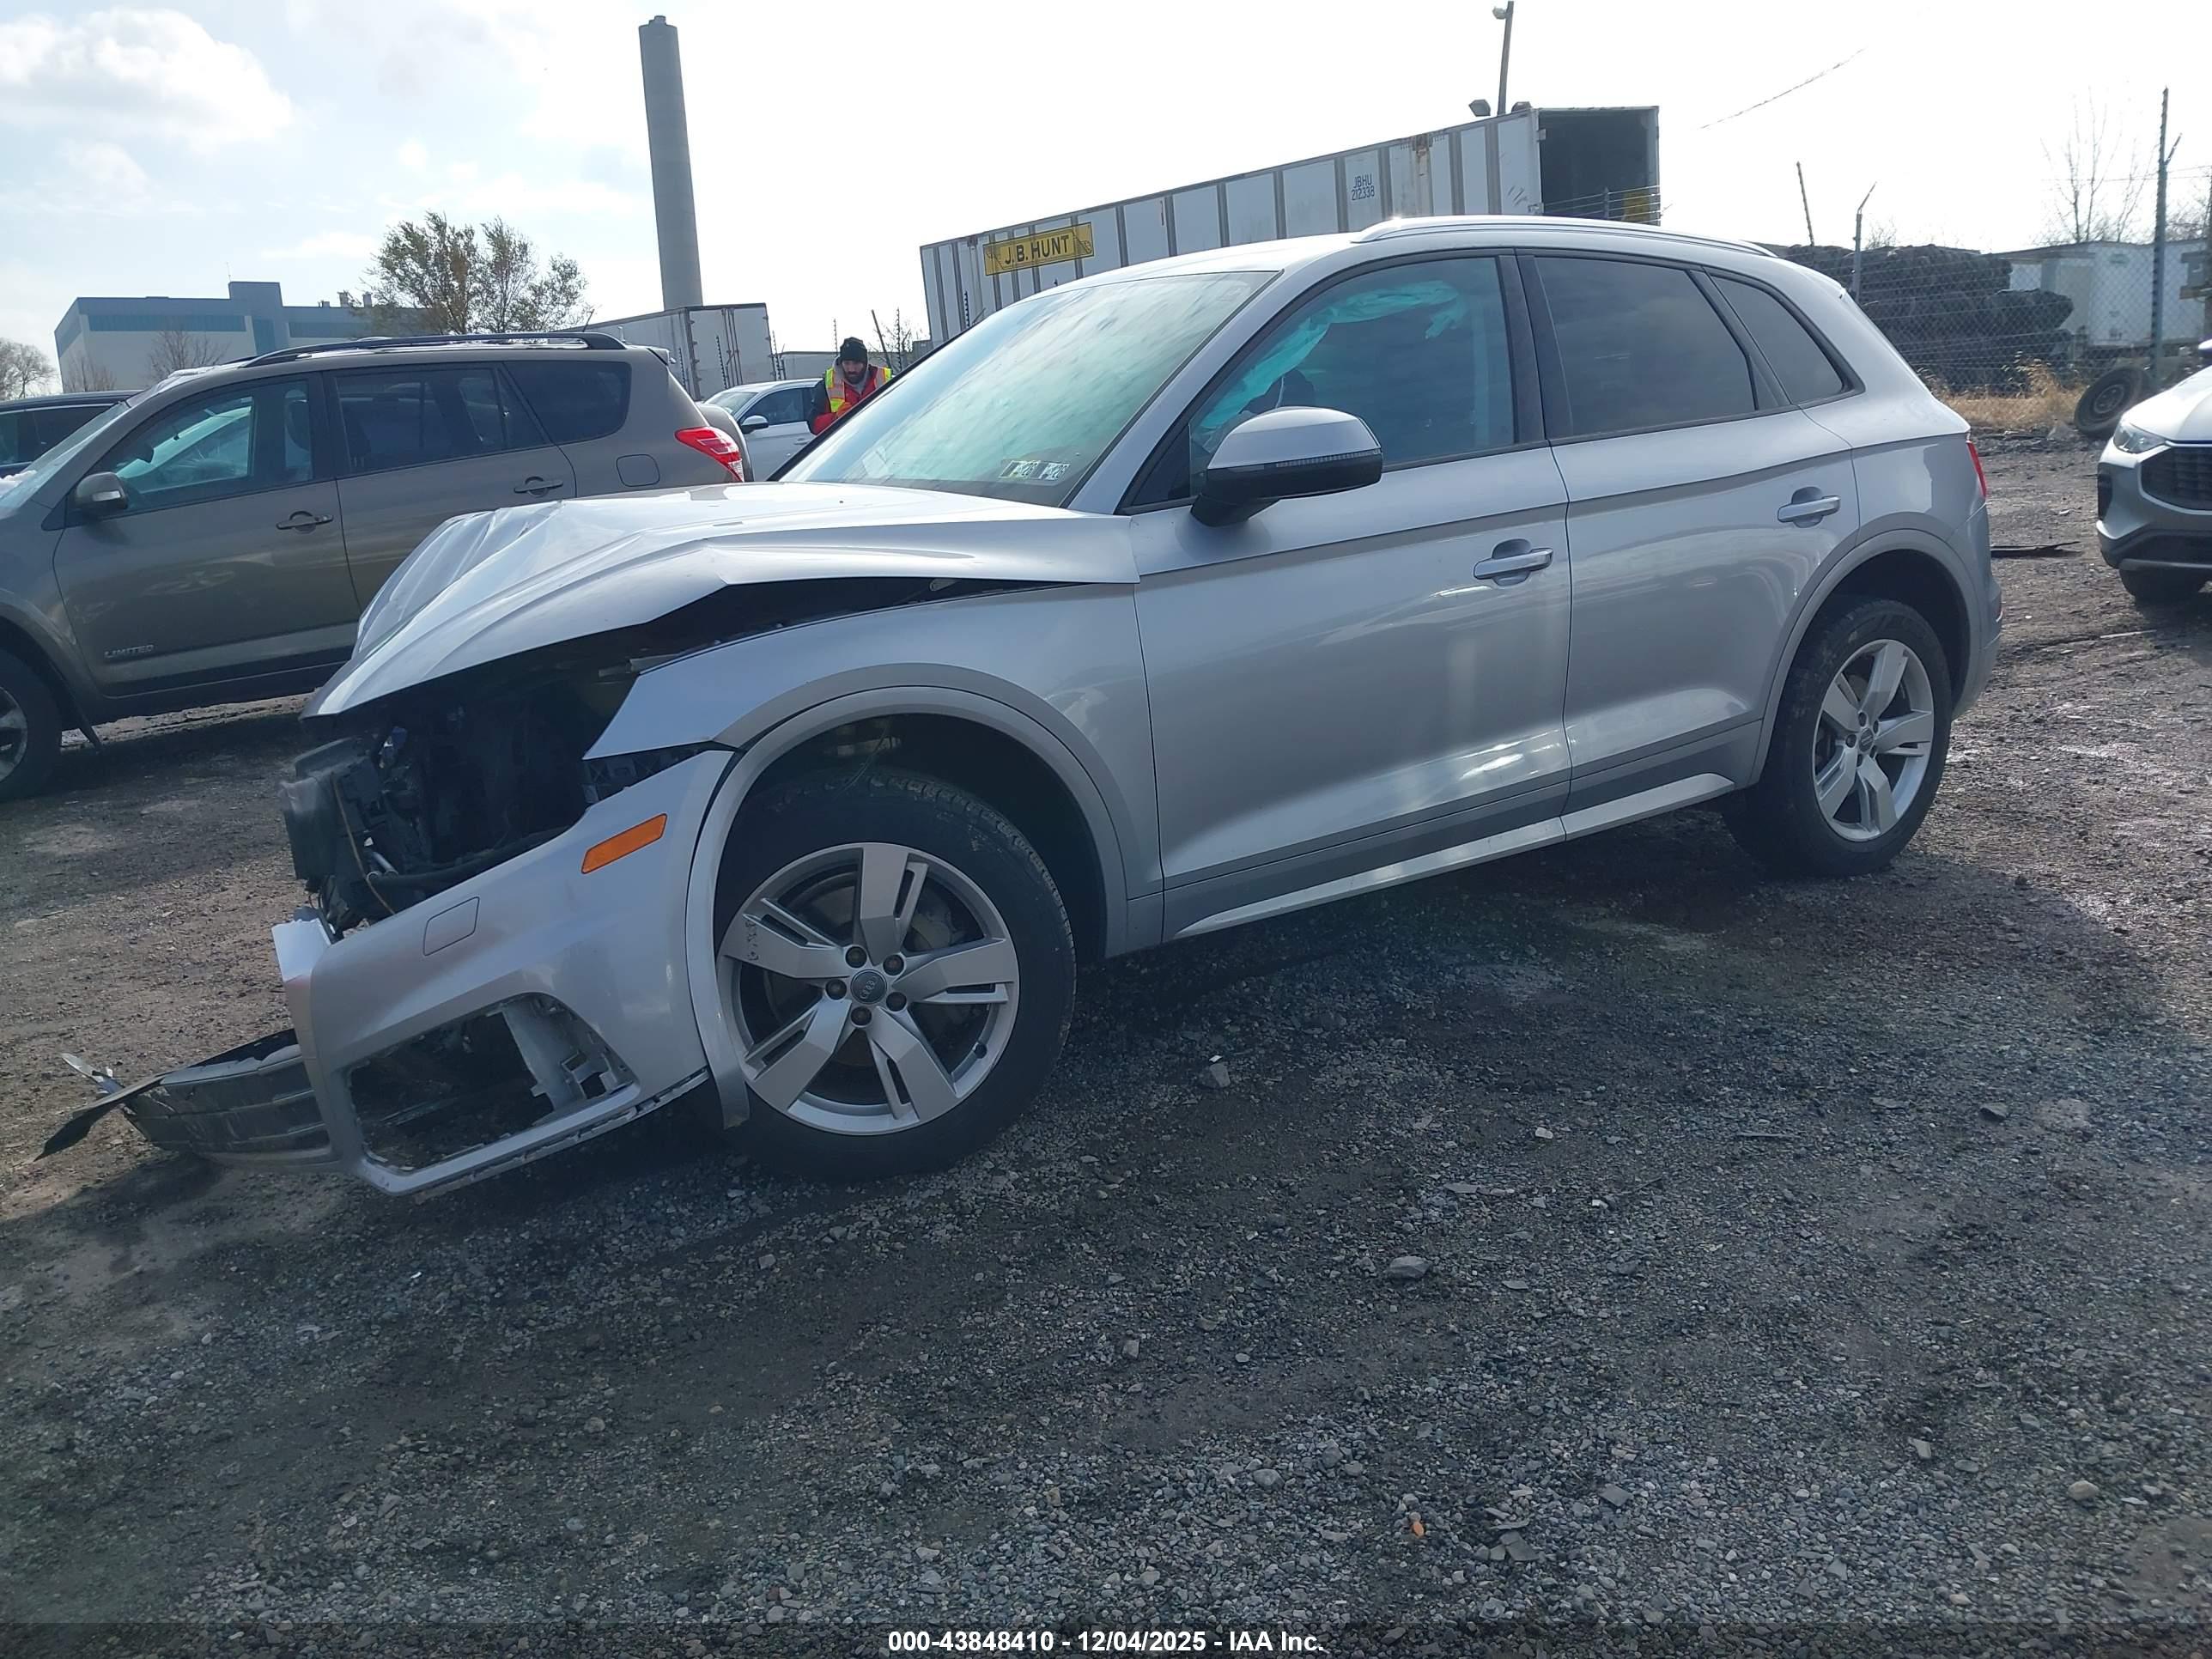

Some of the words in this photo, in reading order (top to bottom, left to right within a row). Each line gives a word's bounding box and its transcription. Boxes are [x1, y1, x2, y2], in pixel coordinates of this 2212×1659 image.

[1354, 173, 1372, 188] JBHU
[1031, 234, 1070, 258] HUNT
[104, 644, 155, 659] LIMITED
